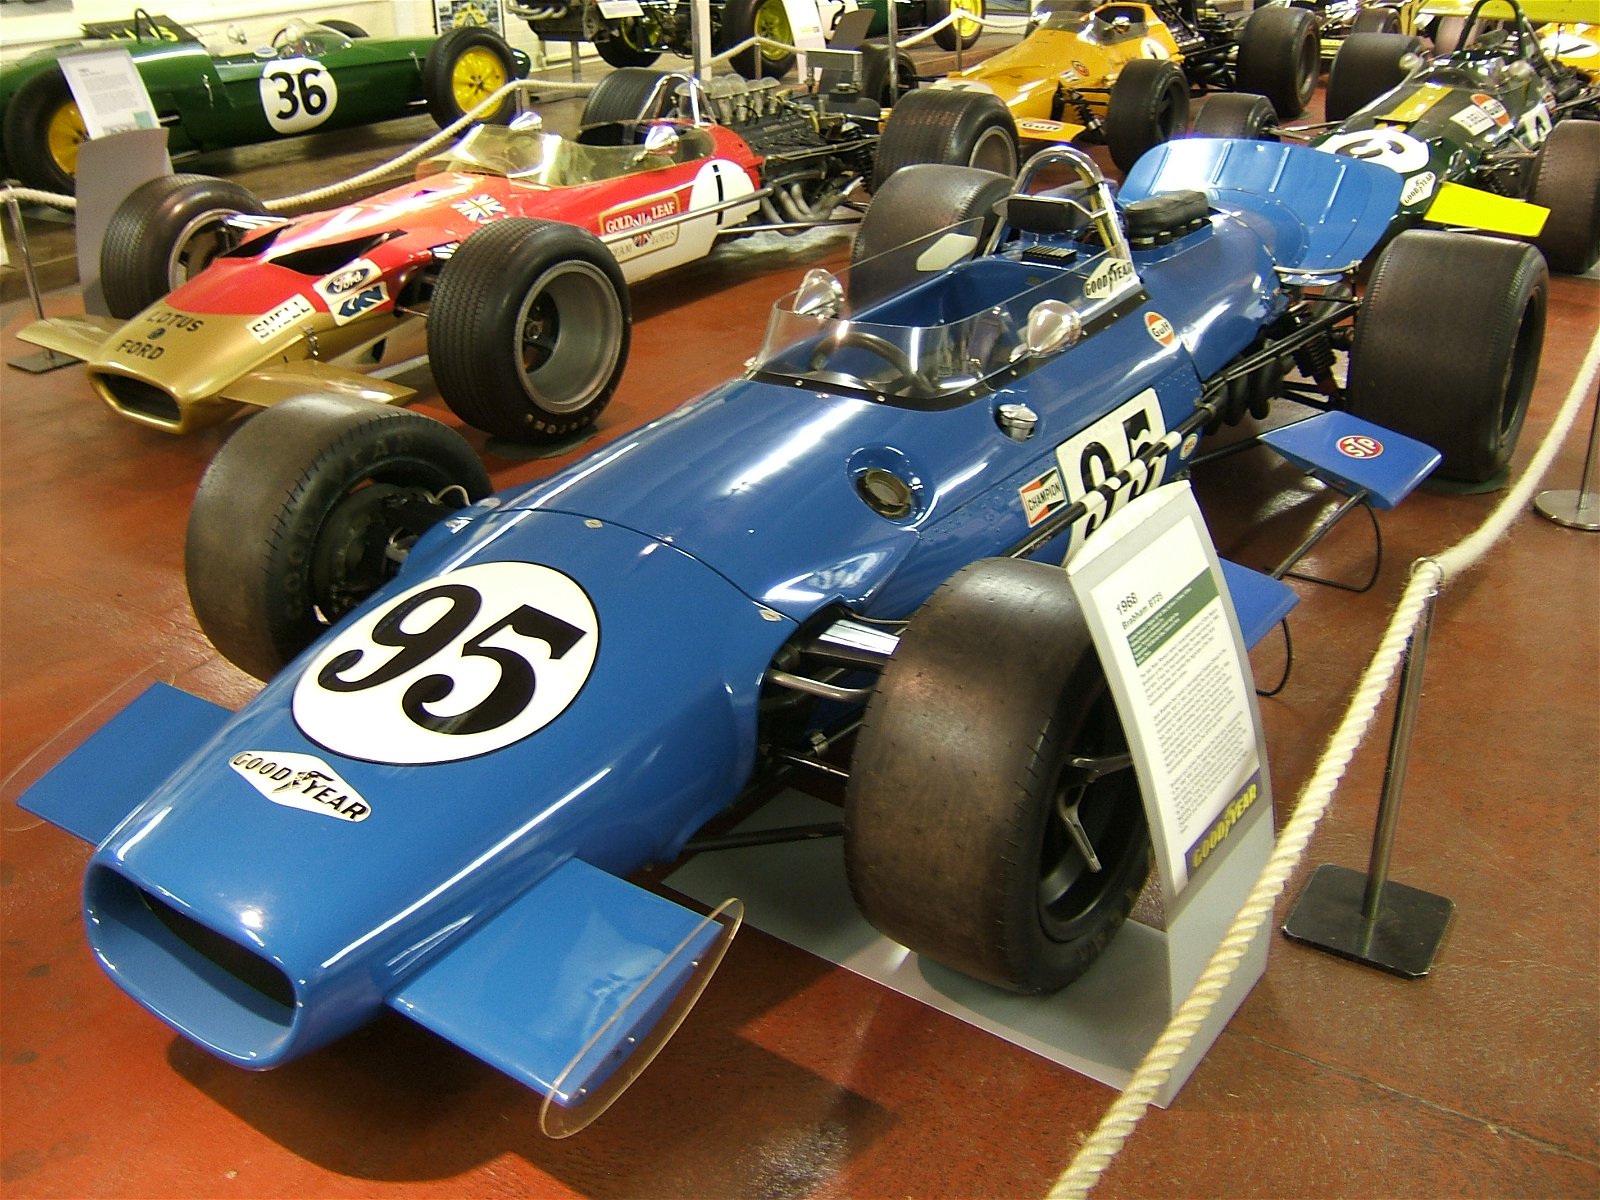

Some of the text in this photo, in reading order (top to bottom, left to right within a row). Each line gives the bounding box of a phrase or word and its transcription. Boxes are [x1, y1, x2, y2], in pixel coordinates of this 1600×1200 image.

[269, 67, 328, 120] 36
[605, 201, 675, 234] GOLD LEAF
[332, 270, 364, 293] Ford
[147, 311, 205, 332] LOTUS
[252, 301, 311, 339] SHELL
[1151, 321, 1171, 337] Gulf
[116, 340, 165, 361] FORD
[1343, 438, 1377, 458] STP
[1027, 483, 1063, 512] CHAMPION
[317, 583, 588, 736] 95
